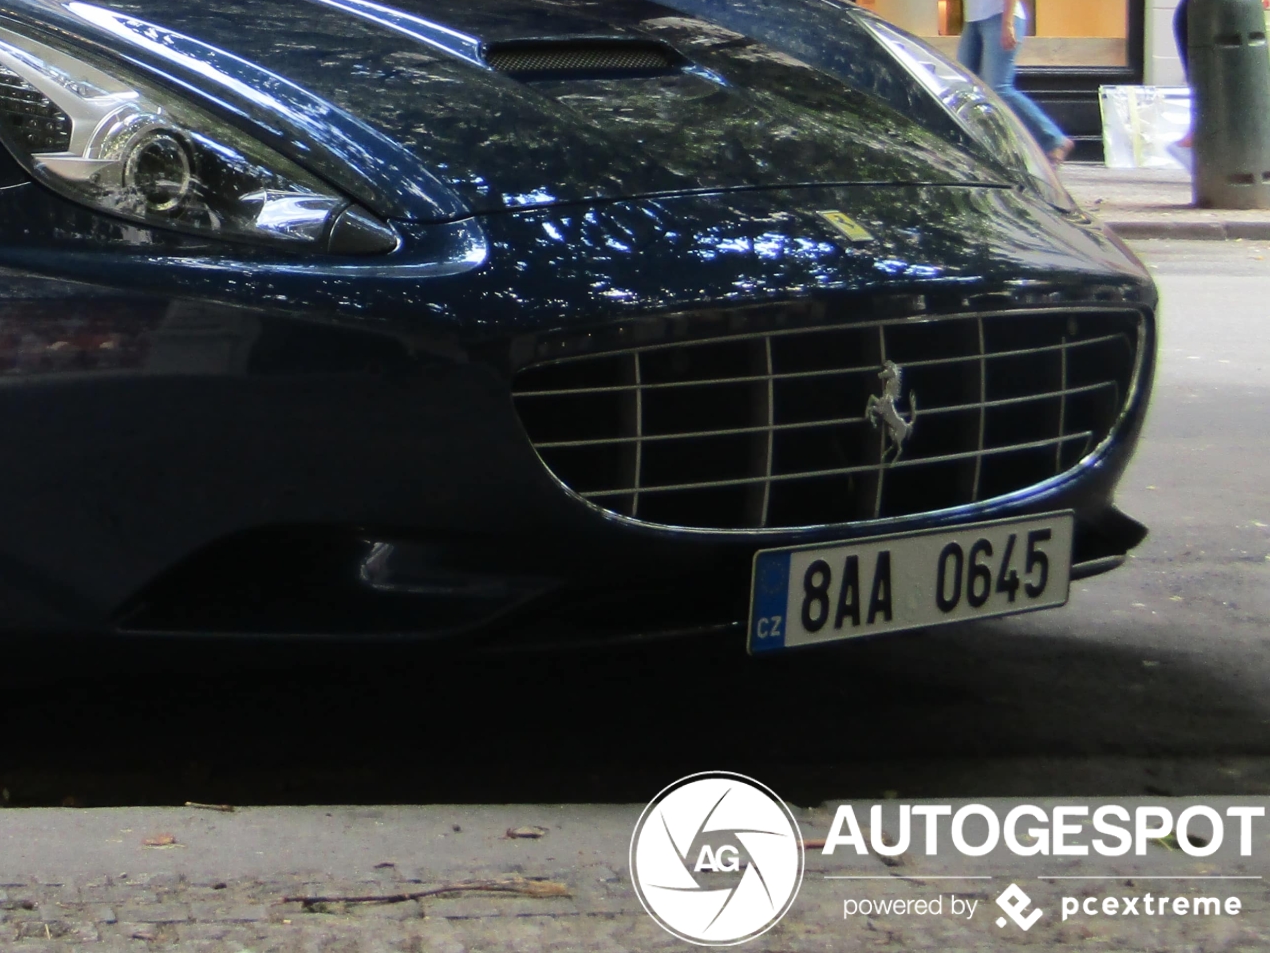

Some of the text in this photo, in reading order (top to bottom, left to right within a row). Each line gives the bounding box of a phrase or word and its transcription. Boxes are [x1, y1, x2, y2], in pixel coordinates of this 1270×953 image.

[801, 527, 1052, 633] 8AA 0645
[756, 615, 781, 638] CZ
